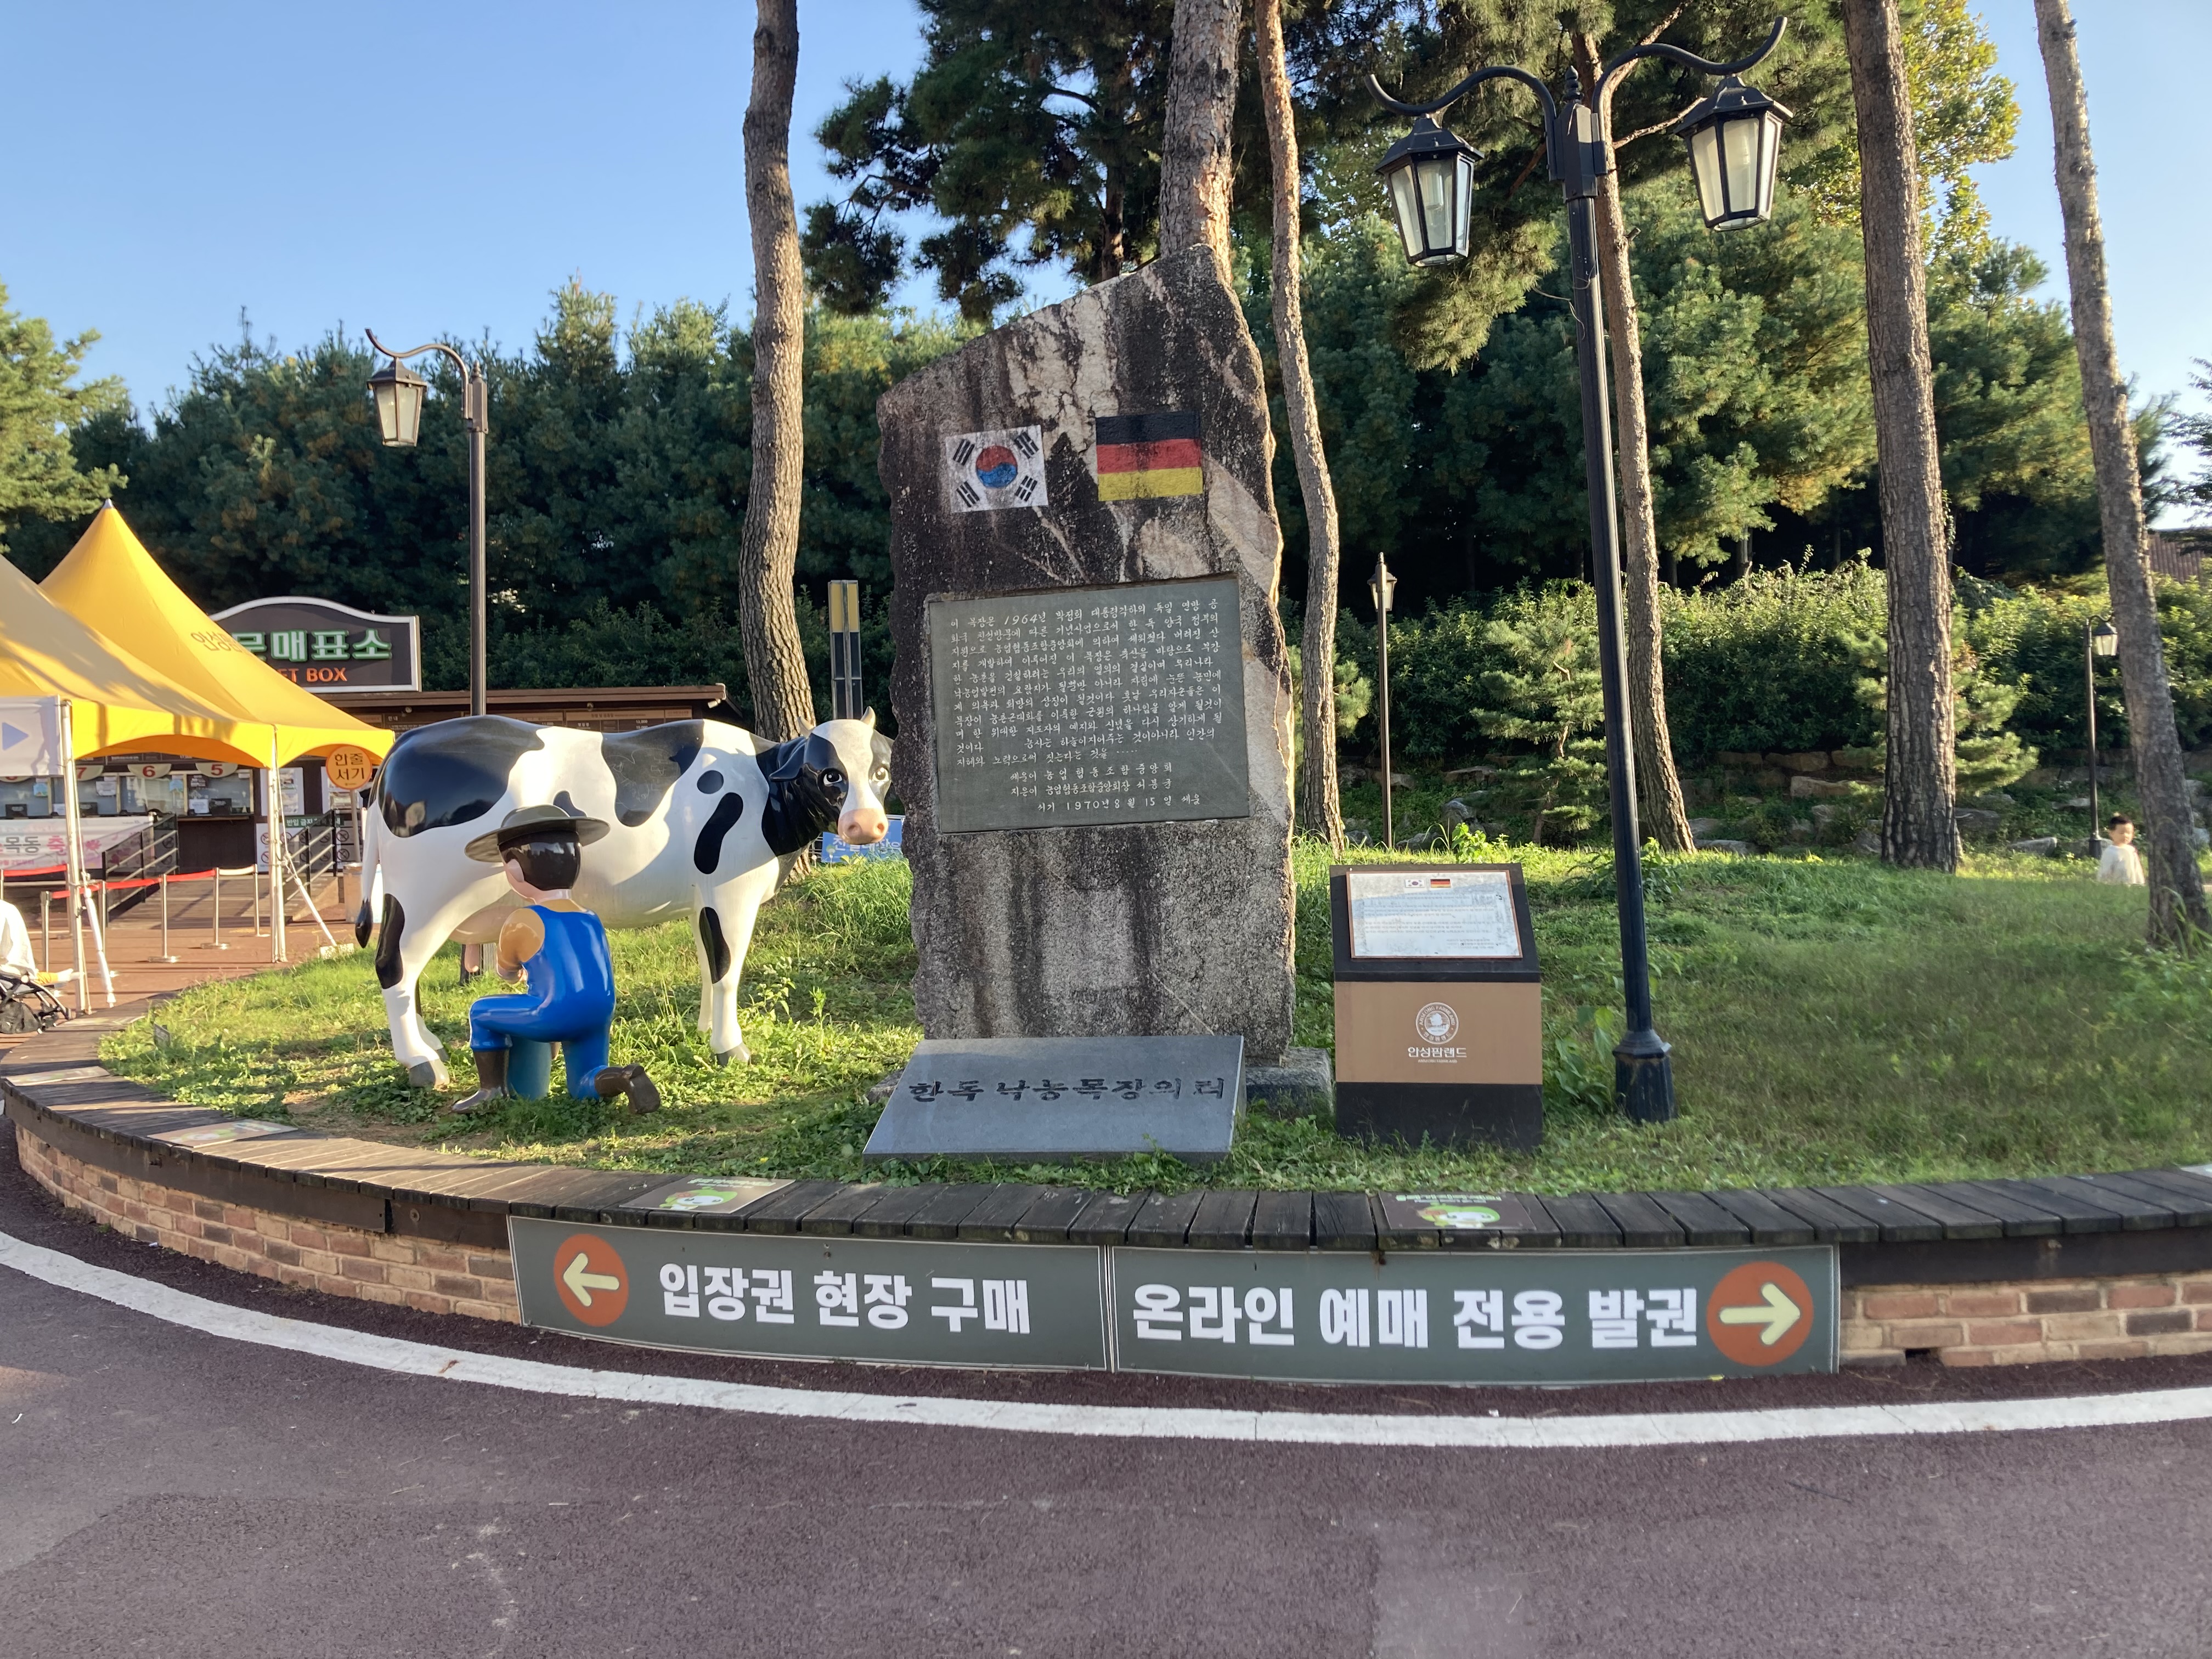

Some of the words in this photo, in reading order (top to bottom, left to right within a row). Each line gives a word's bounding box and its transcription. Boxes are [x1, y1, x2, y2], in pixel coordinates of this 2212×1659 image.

[950, 618, 958, 629] 이
[967, 616, 995, 628] 목장은
[1003, 611, 1046, 625] 1964년
[1055, 608, 1082, 622] 박정희
[1091, 603, 1146, 618] 대통령각하의
[1153, 601, 1172, 614] 독일
[1181, 599, 1200, 611] 연방
[1207, 598, 1218, 610] 공
[951, 632, 967, 645] 화국
[977, 627, 1020, 641] 친선방문에
[1028, 625, 1048, 637] 따른
[1056, 619, 1118, 636] 기념사업으로서
[1128, 619, 1137, 631] 한
[1144, 617, 1155, 629] 독
[1164, 614, 1182, 628] 양국
[1191, 612, 1218, 626] 정부의
[951, 645, 986, 657] 지원으로
[994, 637, 1084, 654] 농업협동조합중앙회에
[1092, 634, 1119, 647] 의하여
[1173, 627, 1200, 640] 버려진
[1209, 626, 1220, 638] 산
[952, 659, 969, 672] 지를
[977, 656, 1012, 669] 개발하여
[1065, 652, 1074, 663] 이
[1084, 650, 1112, 663] 목장은
[1119, 647, 1148, 660] 축산을
[1155, 644, 1194, 656] 바탕으로
[1201, 640, 1221, 653] 부강
[952, 674, 962, 685] 한
[969, 672, 995, 683] 농촌을
[1005, 668, 1049, 681] 건설하려는
[1056, 664, 1085, 679] 우리의
[1093, 662, 1120, 675] 열의의
[1130, 659, 1165, 673] 결실이며
[1174, 656, 1213, 669] 우리나라
[306, 667, 347, 682] BOX
[953, 685, 1005, 699] 낙농업발전의
[1012, 681, 1051, 695] 요람지가
[1094, 676, 1123, 689] 아니라
[1130, 673, 1158, 687] 자립에
[1192, 669, 1221, 682] 농민에
[953, 701, 962, 712] 게
[972, 698, 1000, 711] 의욕과
[1006, 696, 1033, 710] 희망의
[1040, 693, 1068, 707] 상징이
[1211, 683, 1220, 695] 이
[955, 714, 981, 727] 목장이
[1051, 707, 1079, 720] 이룩한
[1085, 704, 1114, 718] 근원의
[1122, 702, 1159, 715] 하나임을
[1168, 699, 1186, 713] 알게
[1194, 697, 1221, 711] 될것이
[955, 728, 963, 740] 며
[972, 727, 983, 738] 한
[991, 725, 1018, 737] 위대한
[1026, 723, 1060, 735] 지도자의
[1069, 720, 1098, 732] 예지와
[1104, 718, 1133, 731] 신념을
[1141, 715, 1159, 727] 다시
[1167, 712, 1205, 727] 상기하게
[1212, 711, 1222, 724] 될
[956, 741, 984, 754] 것이다
[1024, 737, 1052, 749] 농사는
[1186, 727, 1215, 741] 인간의
[142, 765, 156, 777] 6
[211, 764, 223, 776] 5
[956, 755, 985, 768] 지혜와
[992, 752, 1036, 766] 노력으로써
[1045, 750, 1081, 763] 짓는다는
[1090, 747, 1108, 759] 것을
[336, 767, 365, 780] 서기
[1011, 785, 1037, 797] 지은이
[1045, 779, 1131, 795] 농업협동조합중앙회장
[1037, 801, 1054, 812] 서기
[1408, 1047, 1467, 1058] 안성팜랜드
[909, 1078, 984, 1102] 한독
[659, 1263, 794, 1324] 입장권
[814, 1271, 913, 1330] 현장
[930, 1276, 1030, 1334] 구매
[1133, 1284, 1295, 1346] 온라인
[1319, 1288, 1428, 1348] 예매
[1454, 1290, 1565, 1350] 전용
[1589, 1288, 1697, 1348] 발권
